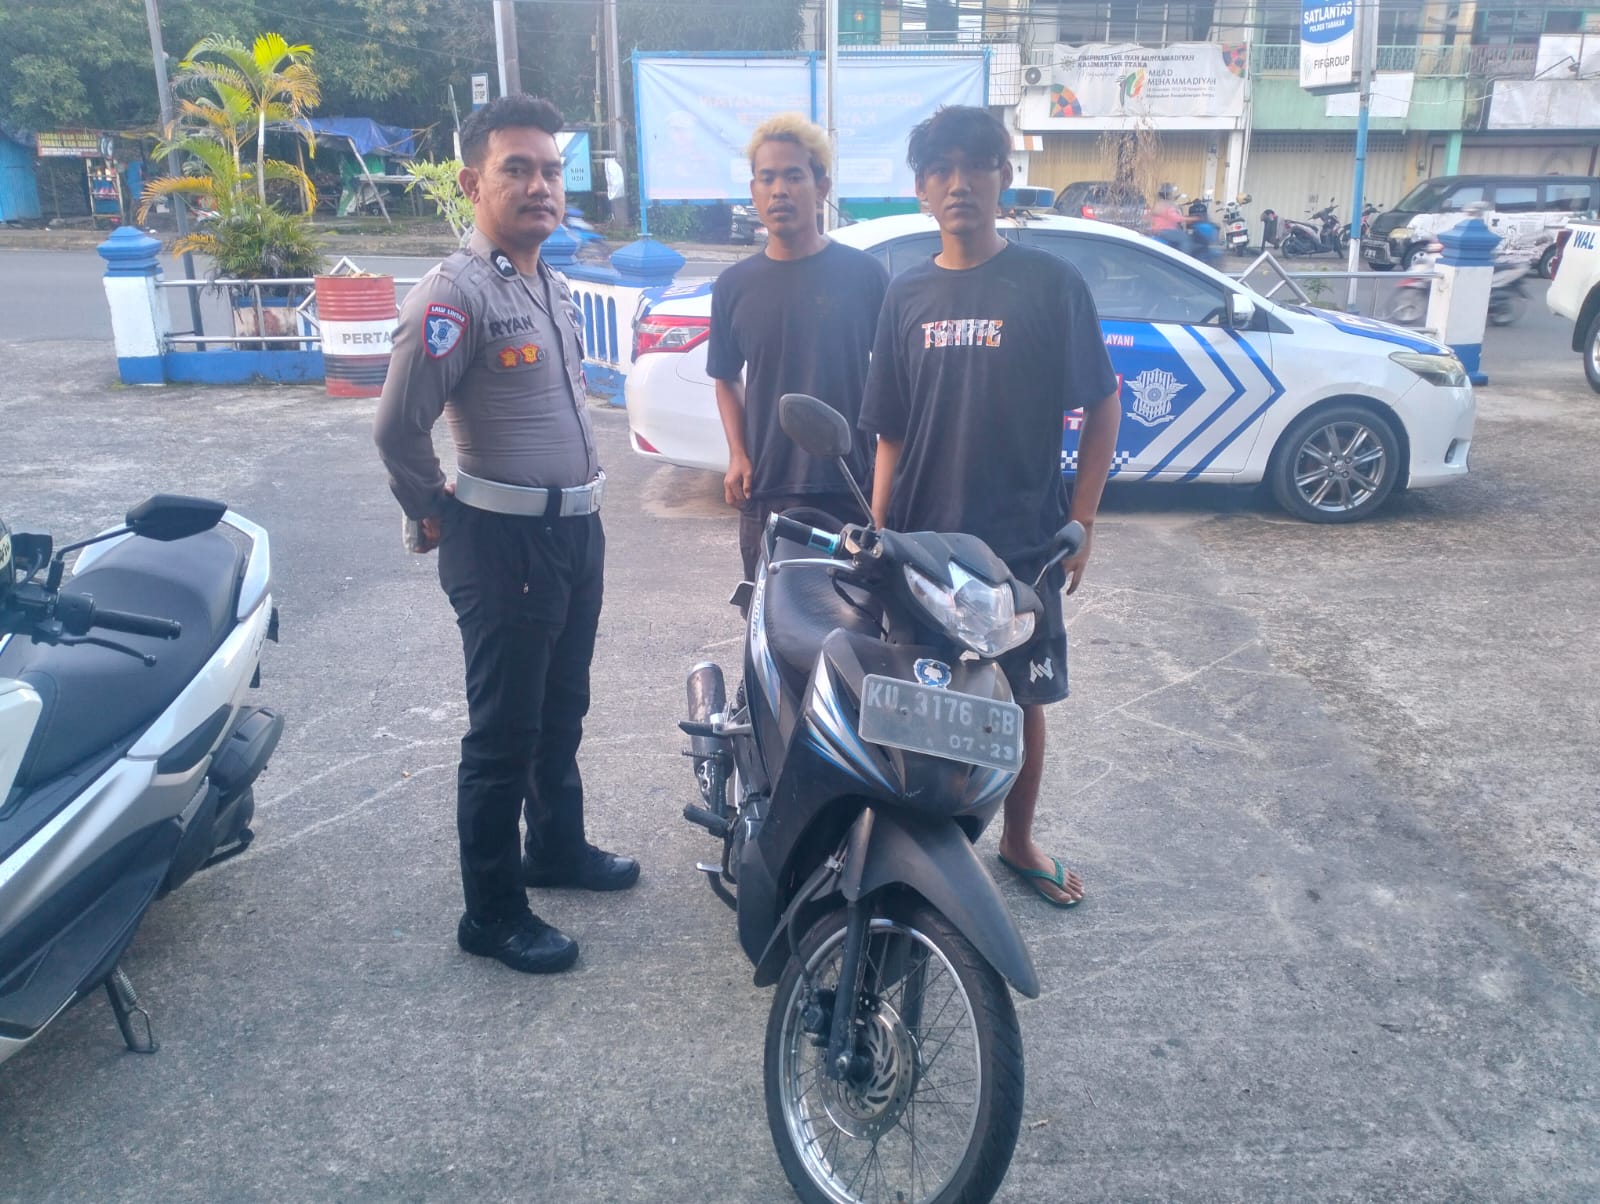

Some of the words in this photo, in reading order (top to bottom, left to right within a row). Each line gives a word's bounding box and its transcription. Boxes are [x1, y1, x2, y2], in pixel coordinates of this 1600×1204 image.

[1303, 1, 1352, 24] SATLANTAS
[1313, 55, 1350, 70] FIFGROUP
[1573, 230, 1596, 250] WAL
[431, 305, 446, 313] LALU
[447, 308, 466, 323] LINTAS
[489, 315, 535, 338] RYAN
[1103, 334, 1135, 347] AYANI
[867, 681, 900, 710] KU
[914, 691, 974, 726] 3176
